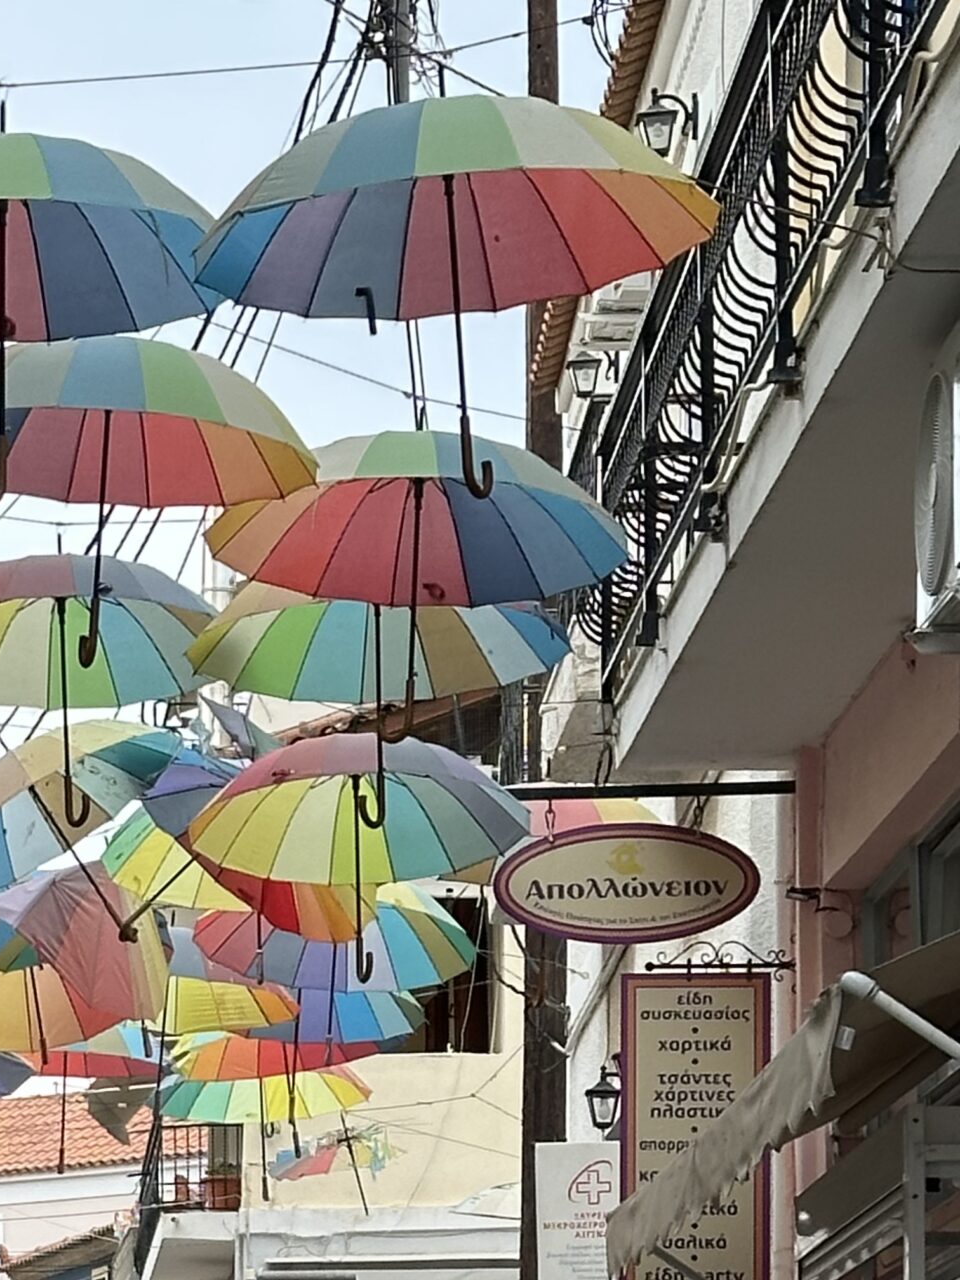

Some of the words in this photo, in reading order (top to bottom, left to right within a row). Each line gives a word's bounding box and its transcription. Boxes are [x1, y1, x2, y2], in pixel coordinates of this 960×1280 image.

[525, 877, 729, 901] Απολλώνειον
[676, 991, 713, 1006] είδη
[640, 1006, 751, 1022] συσκευασίας
[657, 1035, 732, 1054] χαρτικά
[656, 1069, 732, 1088] τσάντες
[653, 1086, 736, 1105] χάρτινες
[649, 1103, 726, 1119] πλαστικ
